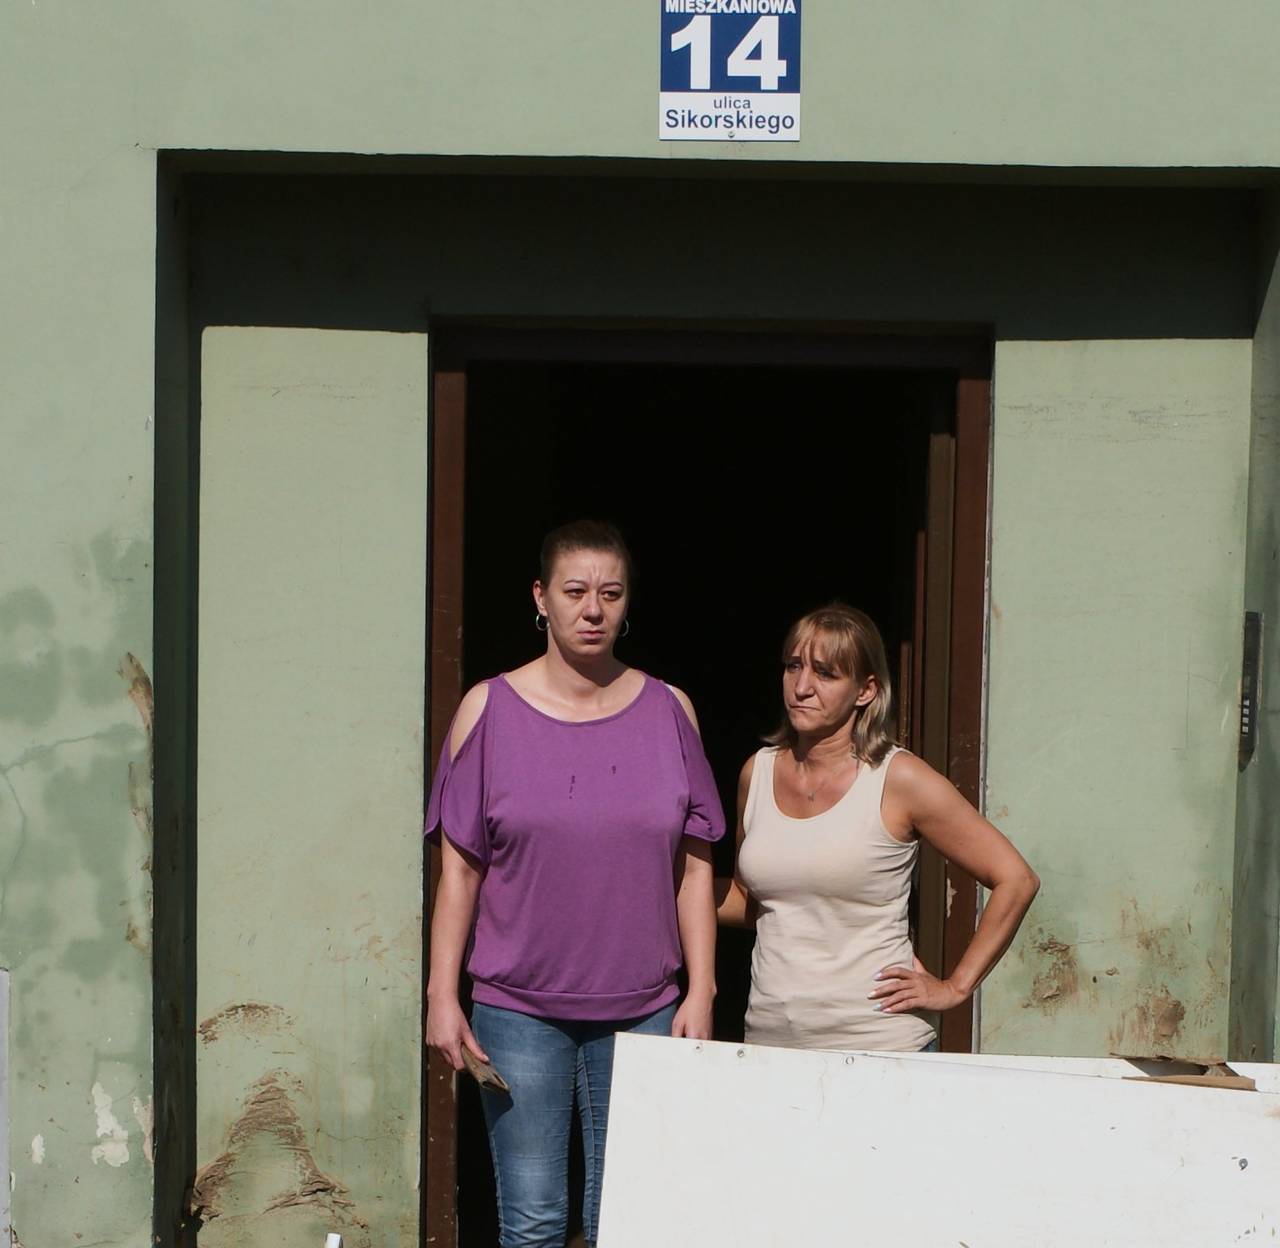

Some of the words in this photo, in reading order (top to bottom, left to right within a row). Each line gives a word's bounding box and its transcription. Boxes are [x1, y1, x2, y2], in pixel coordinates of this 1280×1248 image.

[666, 0, 797, 14] MIESZKANIOWA
[671, 15, 787, 90] 14
[713, 96, 751, 109] ulica
[665, 109, 795, 134] Sikorskiego
